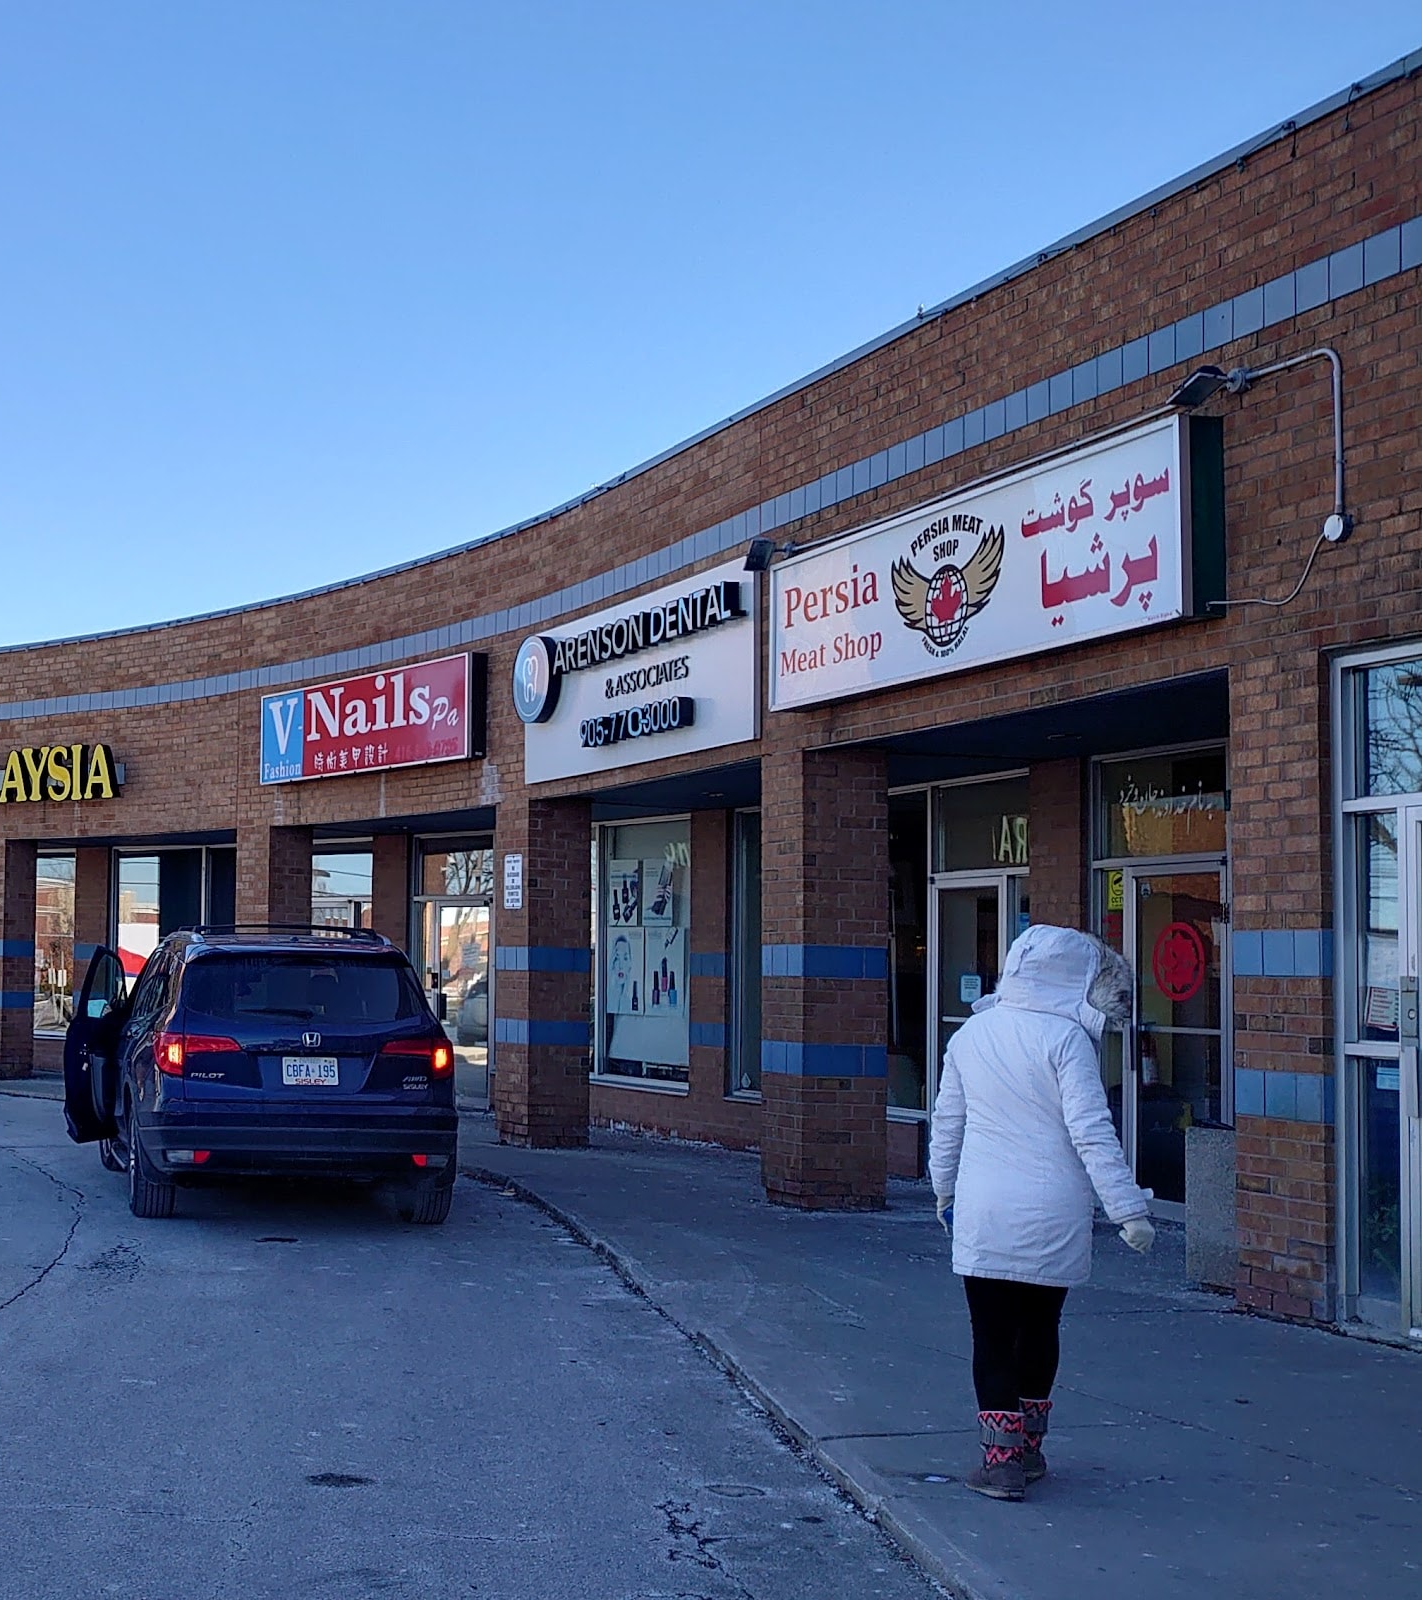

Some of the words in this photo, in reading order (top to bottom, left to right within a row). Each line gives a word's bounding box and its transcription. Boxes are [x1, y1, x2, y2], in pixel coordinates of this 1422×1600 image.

[1020, 478, 1094, 539] گوشت
[1103, 466, 1170, 522] سوپر
[910, 516, 950, 558] PERSIA
[951, 514, 984, 536] MEAT
[932, 538, 960, 563] SHOP
[784, 563, 879, 630] Persia
[1040, 532, 1158, 627] پرشیا
[552, 611, 645, 677] ARENSON
[648, 581, 733, 646] DENTAL
[780, 643, 827, 677] Meat
[832, 630, 883, 665] Shop
[614, 655, 692, 696] ASSOCIATES
[305, 672, 431, 742] Nails
[579, 695, 681, 748] 905-770-3000
[263, 759, 302, 781] Fashion
[286, 1064, 311, 1078] CBFA
[318, 1064, 336, 1079] 195
